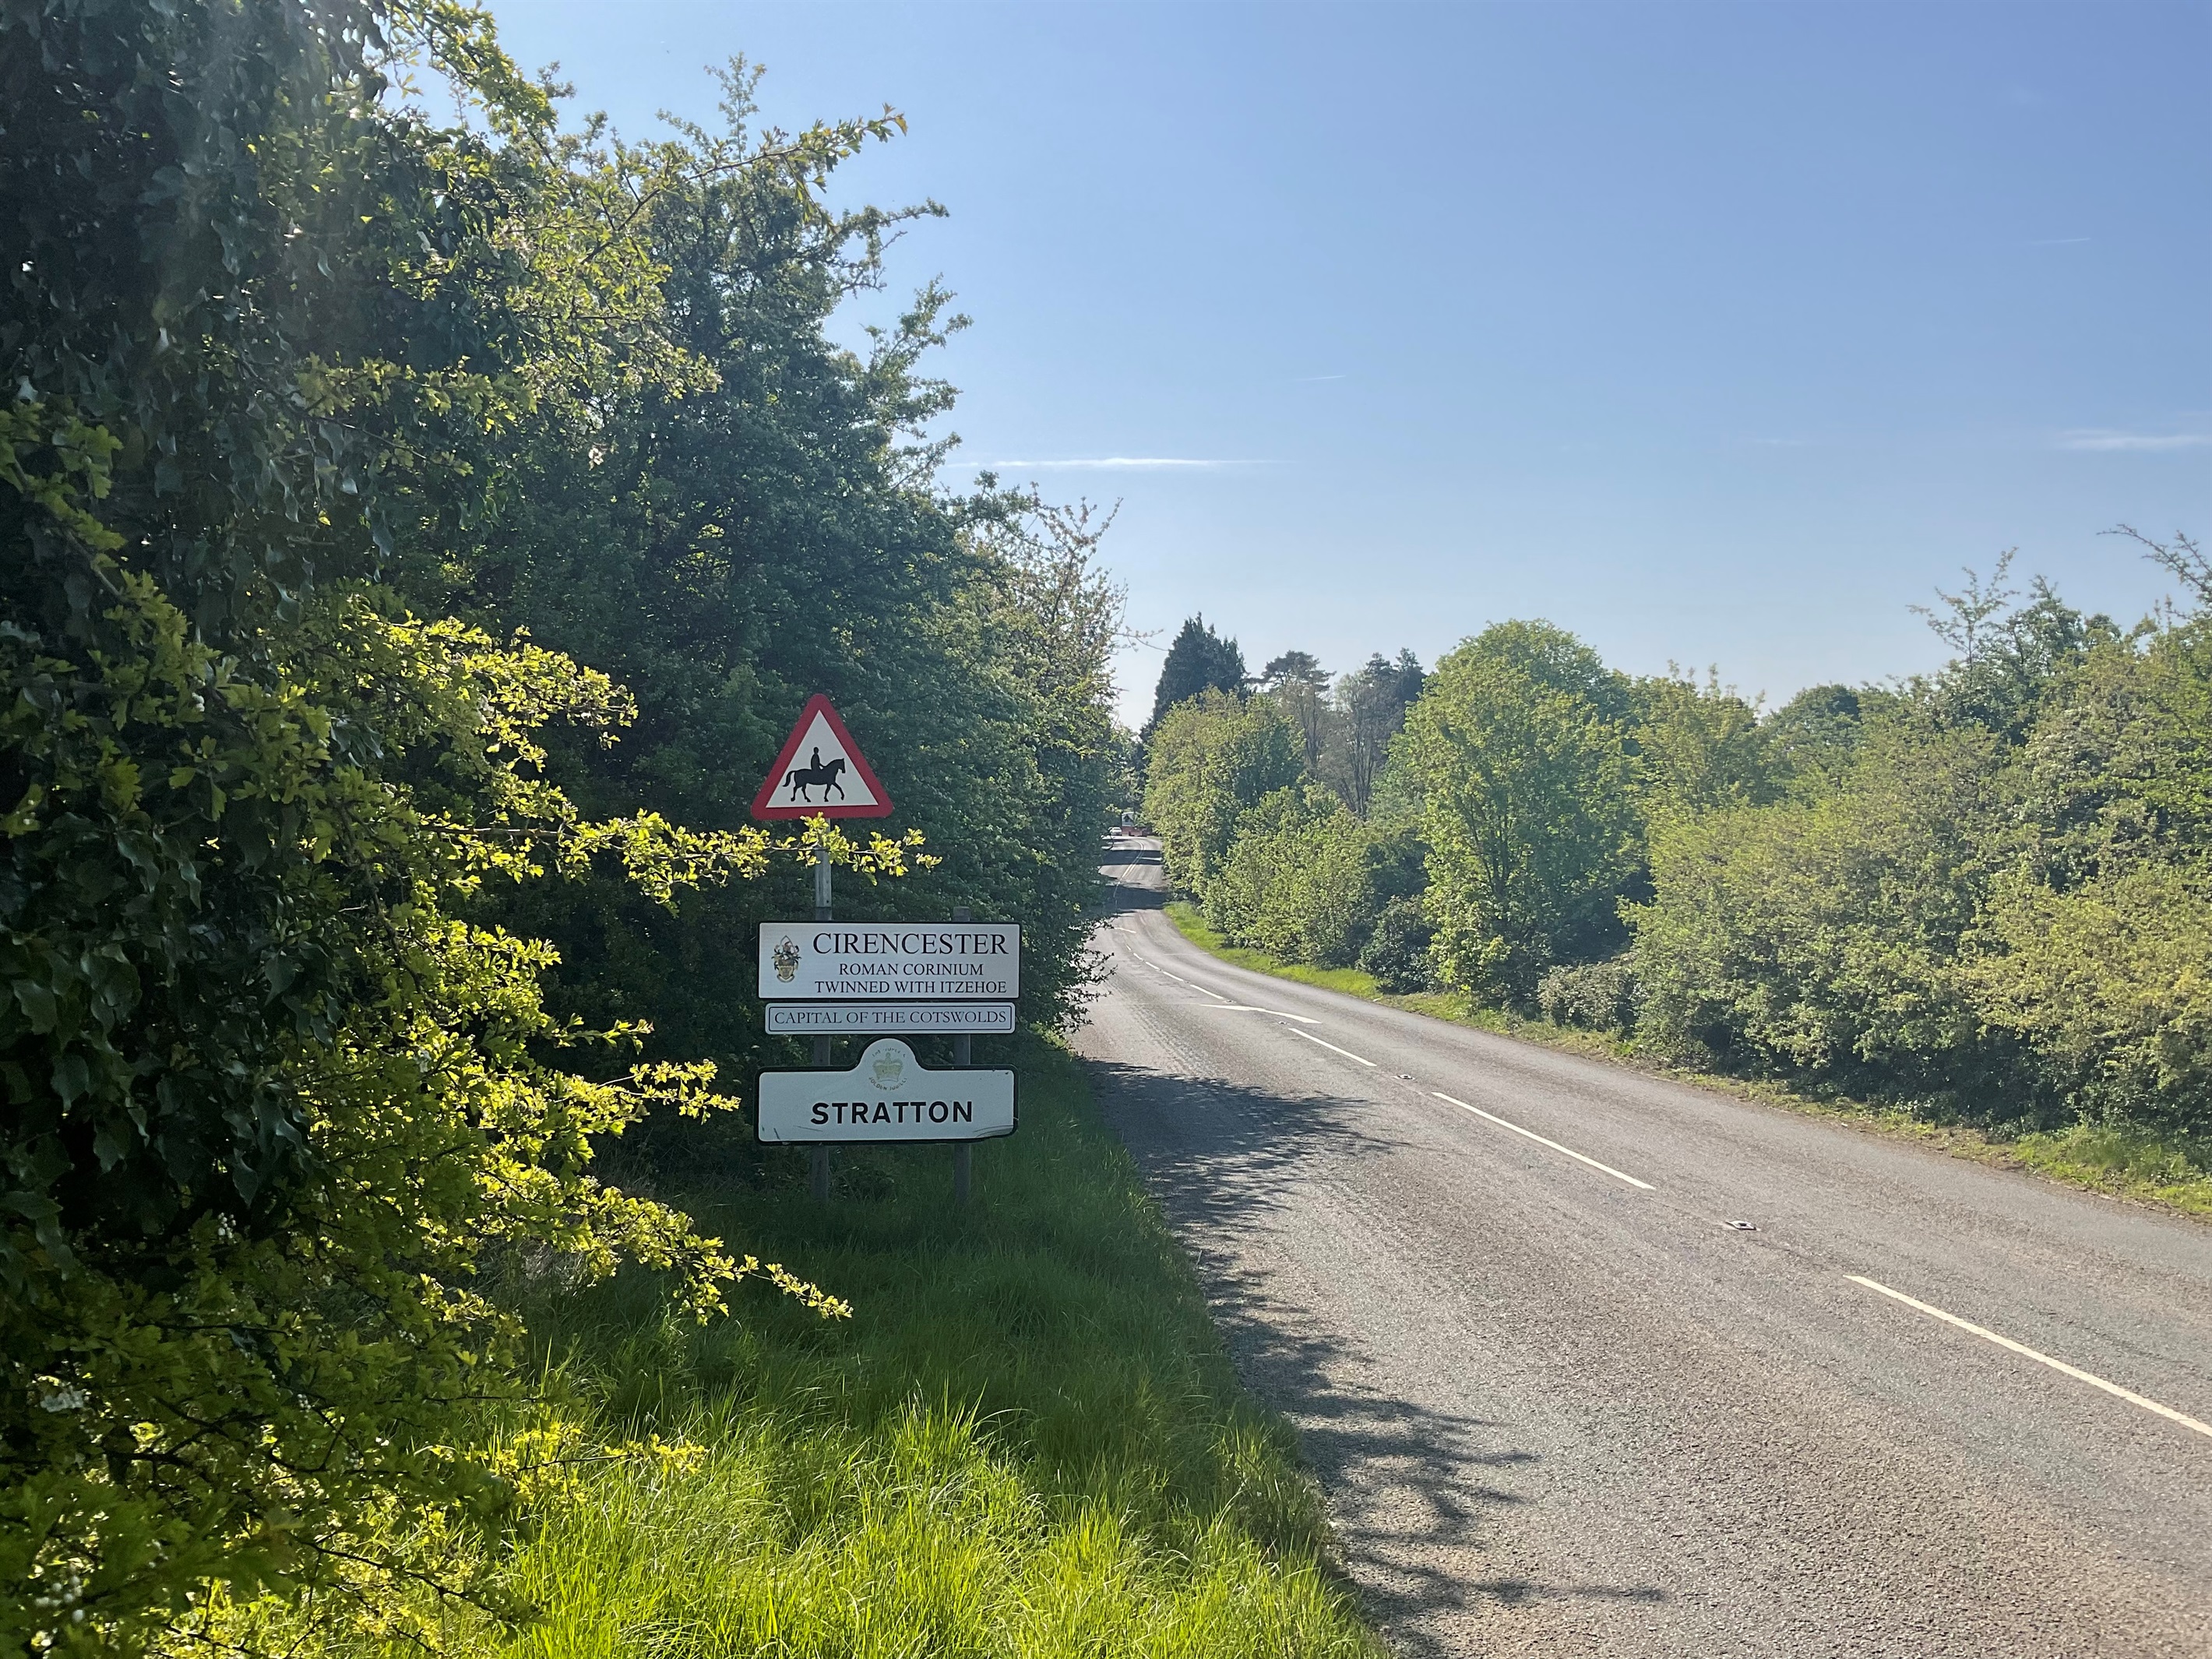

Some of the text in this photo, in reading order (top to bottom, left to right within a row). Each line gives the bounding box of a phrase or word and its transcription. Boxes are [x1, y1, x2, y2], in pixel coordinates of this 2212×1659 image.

[812, 932, 1009, 955] CIRENCESTER
[839, 963, 984, 976] ROMAN CORINIUM
[814, 981, 1007, 994] TWINNED WITH ITZEHOE
[774, 1011, 1006, 1024] CAPITAL OF THE COTSWOLDS
[810, 1101, 972, 1125] STRATTON
